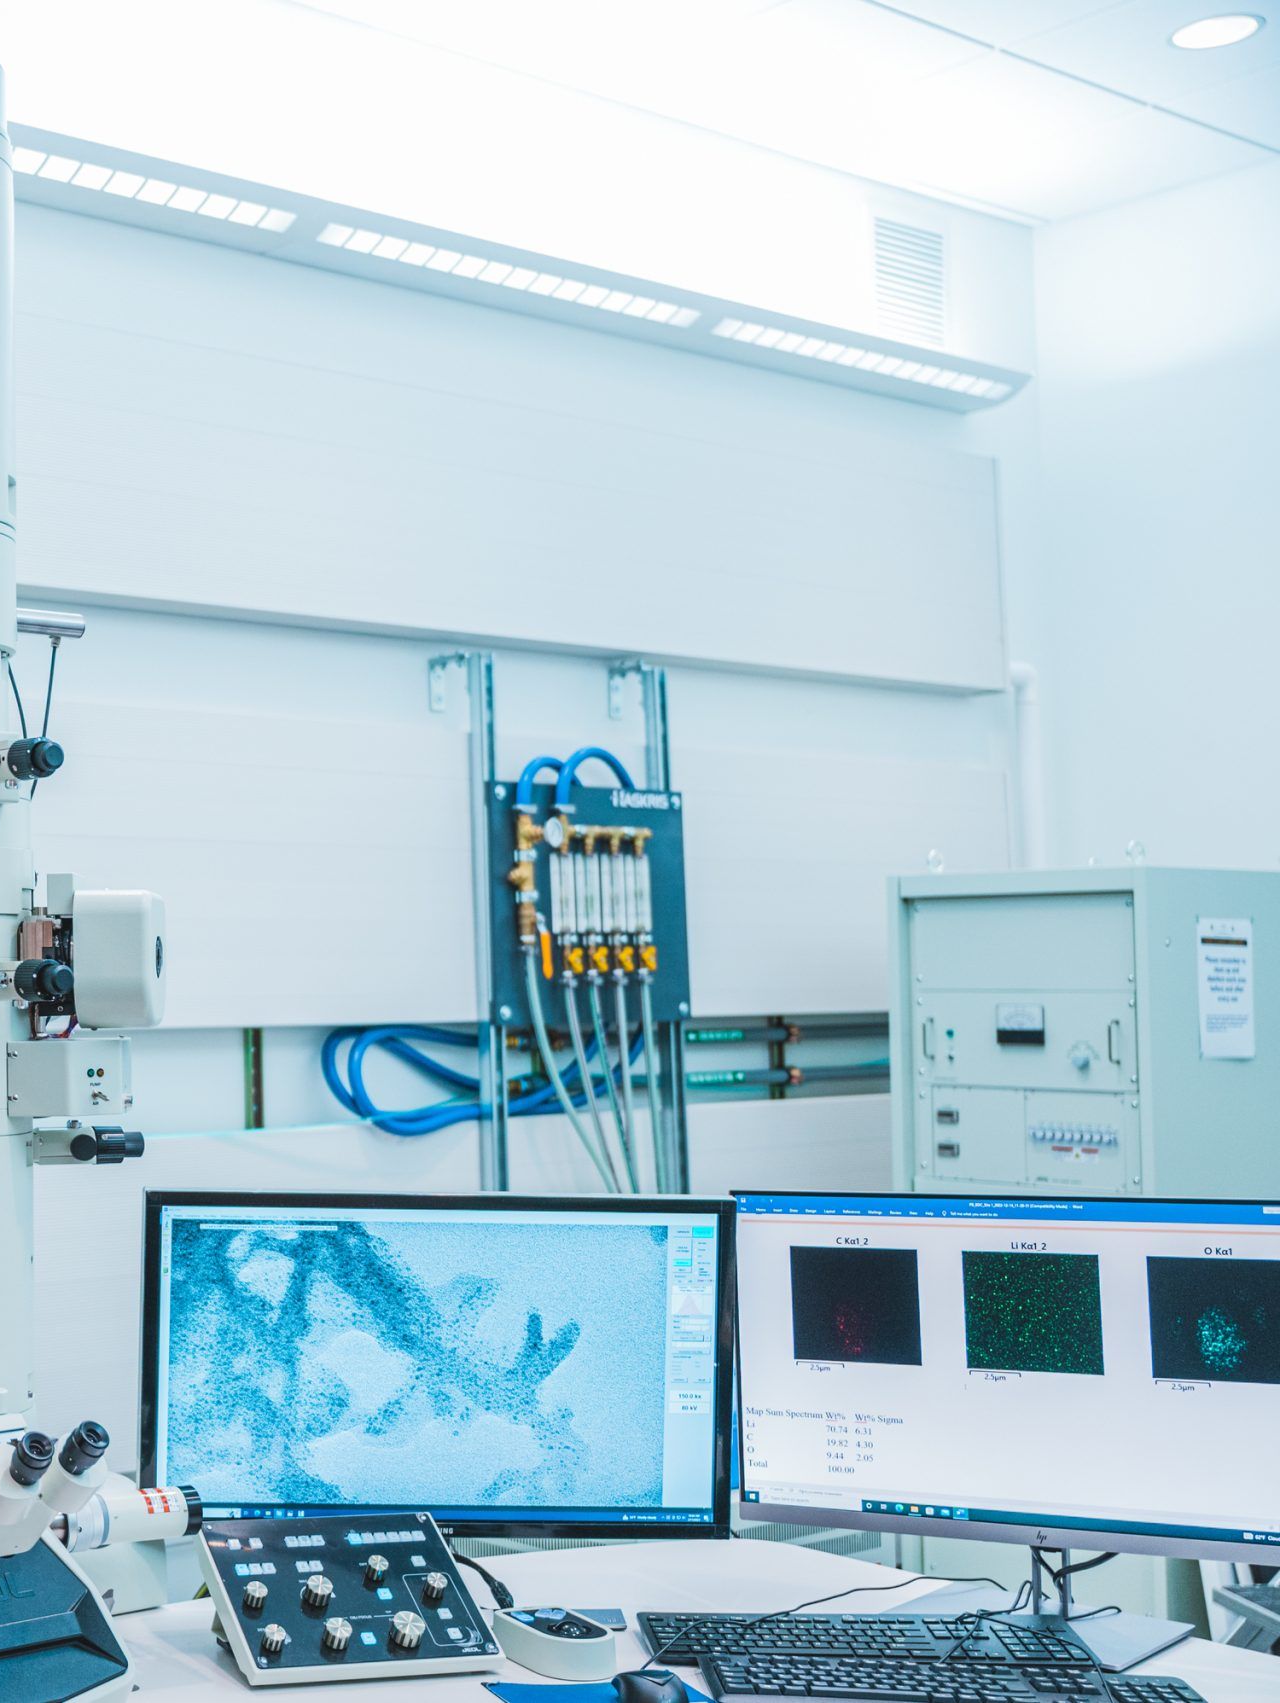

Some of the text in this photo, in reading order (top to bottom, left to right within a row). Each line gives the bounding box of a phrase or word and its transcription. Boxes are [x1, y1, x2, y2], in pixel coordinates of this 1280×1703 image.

[836, 1237, 842, 1245] C
[1010, 1242, 1018, 1250] Li
[1204, 1247, 1212, 1255] O
[810, 1364, 831, 1372] 2.5μm
[984, 1373, 1006, 1382] 2.5μm
[1171, 1383, 1195, 1392] 2.5μm
[746, 1406, 904, 1426] Map Sum Spectrum Wt% Wt% Sigma
[746, 1420, 872, 1436] Li 70.74 6.31
[826, 1438, 848, 1448] 19.82
[856, 1440, 874, 1449] 4.30
[826, 1452, 844, 1460] 9.44
[856, 1454, 874, 1462] 2.05
[748, 1459, 854, 1474] Total 100.00
